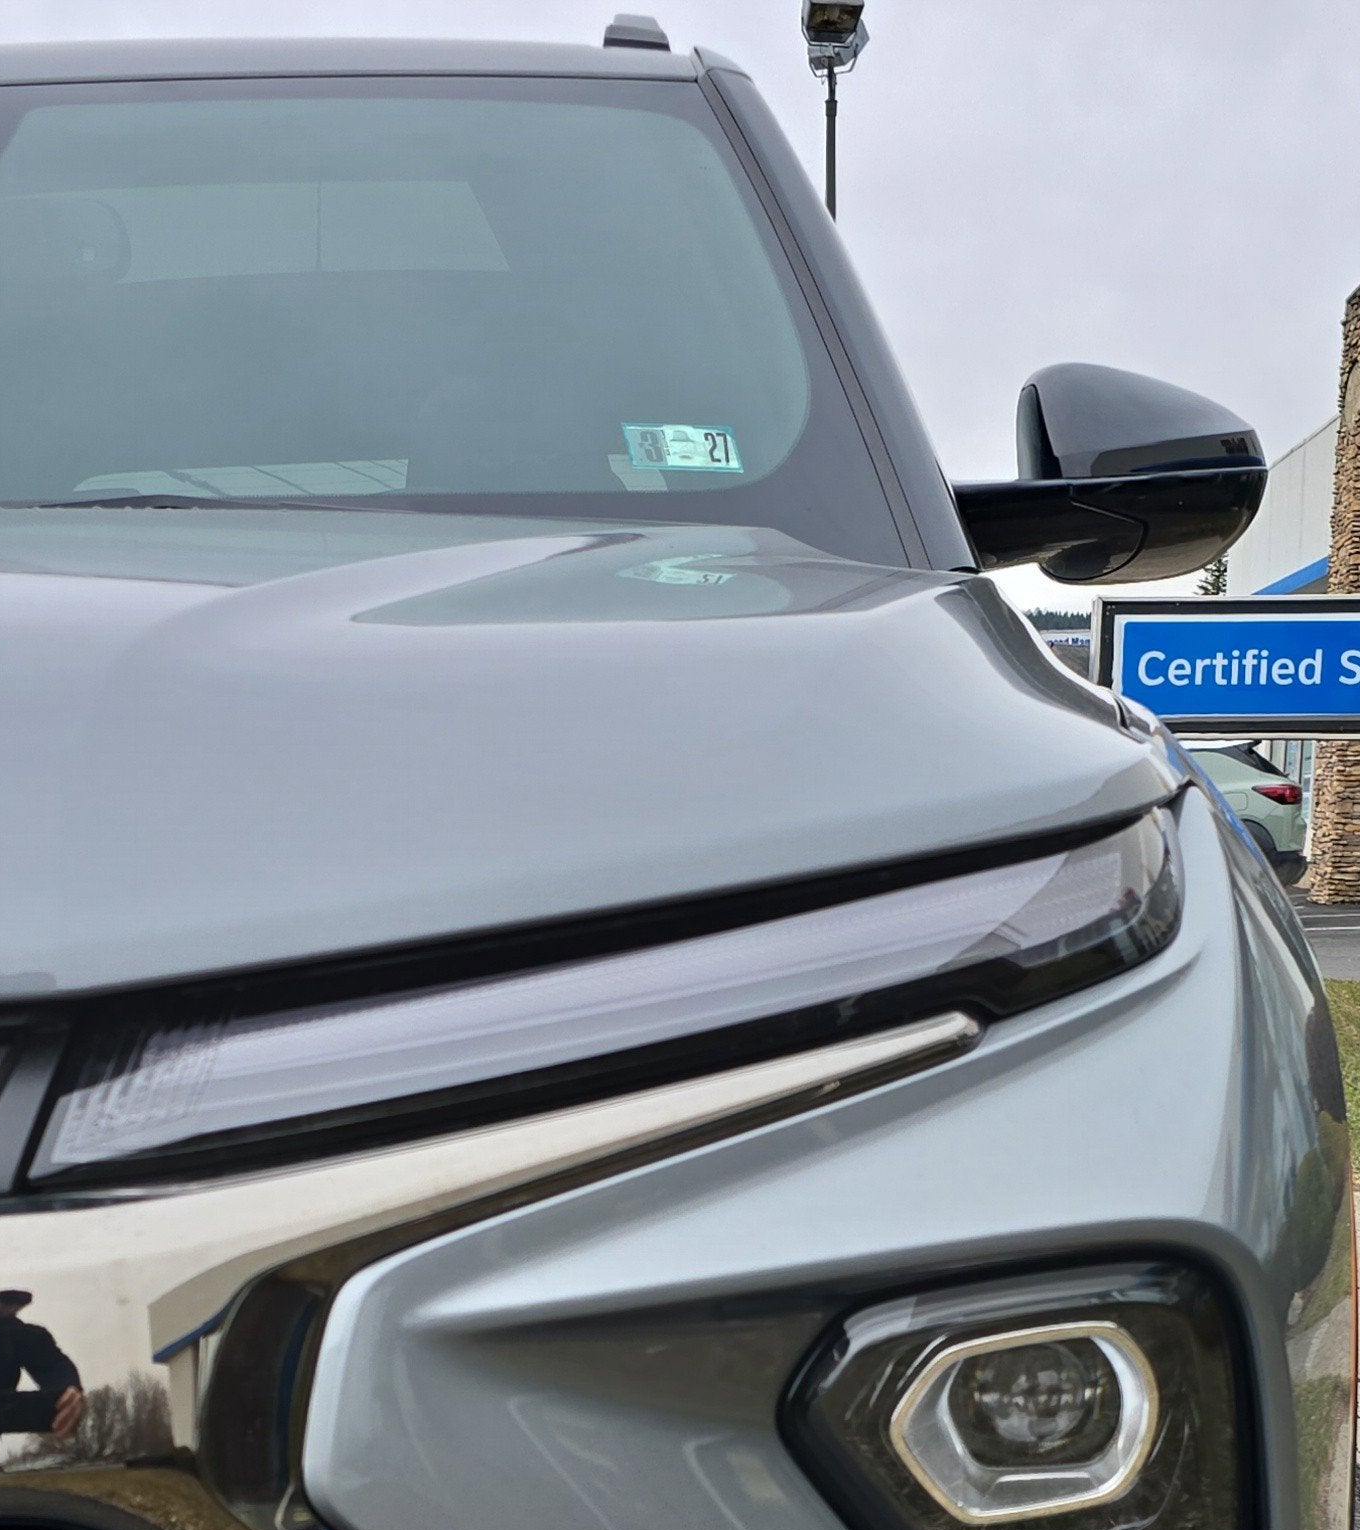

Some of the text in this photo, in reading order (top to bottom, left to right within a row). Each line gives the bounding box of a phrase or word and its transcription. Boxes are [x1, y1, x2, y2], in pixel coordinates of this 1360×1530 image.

[639, 430, 664, 463] 3
[704, 432, 731, 464] 27
[1137, 648, 1323, 687] Certified
